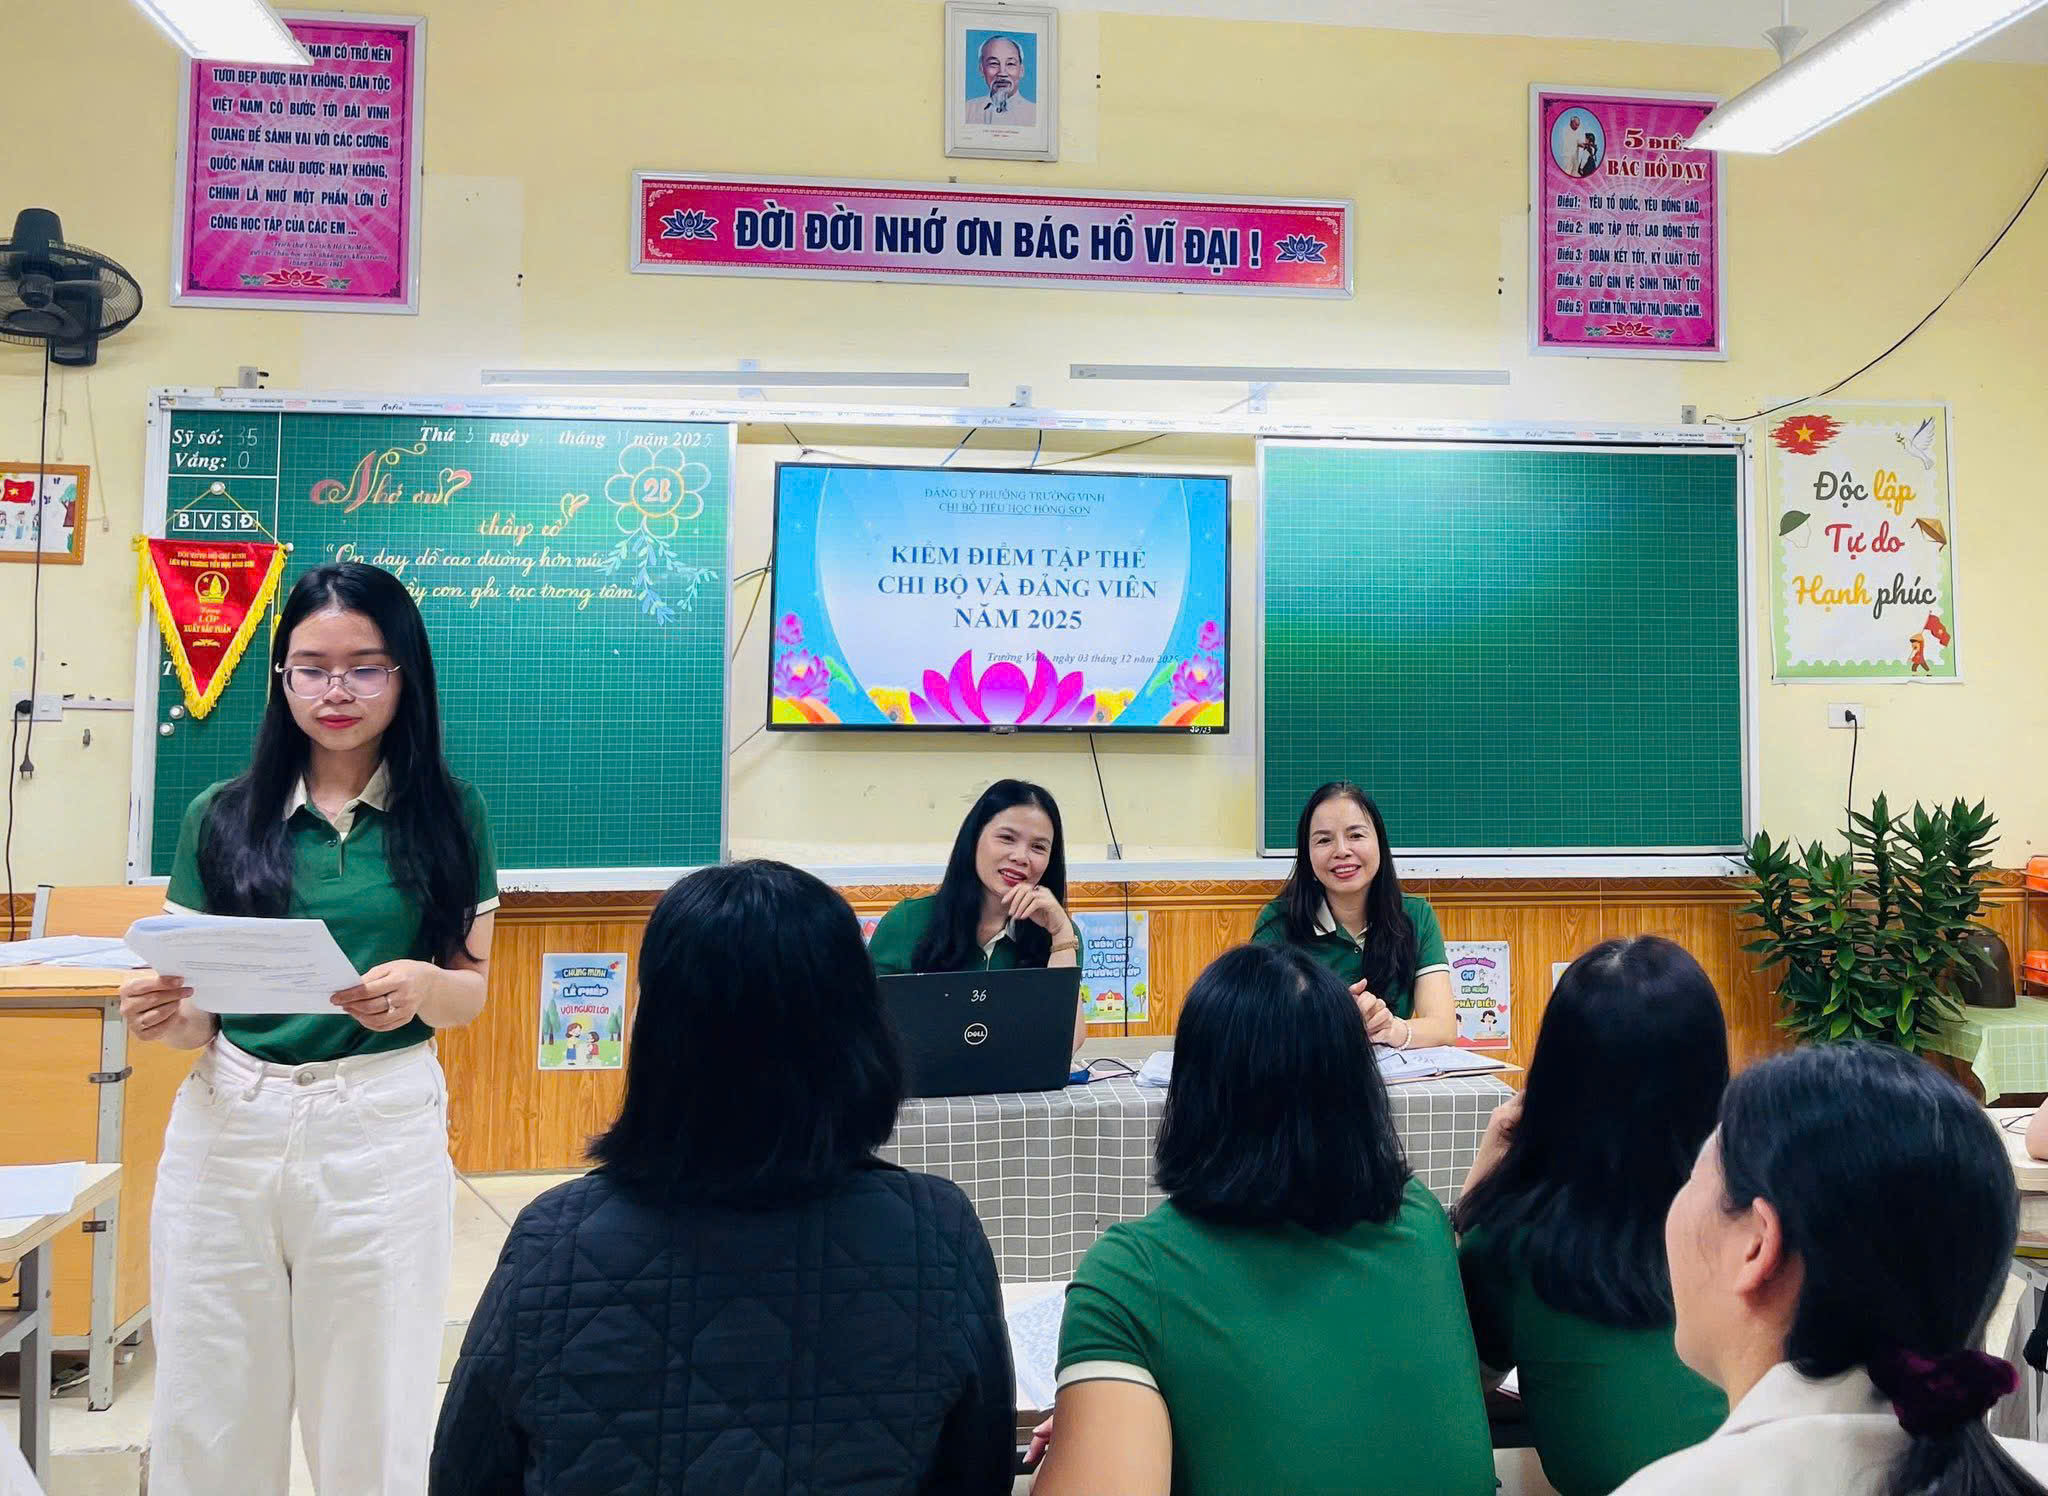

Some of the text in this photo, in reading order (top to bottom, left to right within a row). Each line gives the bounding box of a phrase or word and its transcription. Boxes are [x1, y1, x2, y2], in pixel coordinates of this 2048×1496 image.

[309, 42, 391, 61] NAM CÓ TRỞ NÊN
[213, 68, 235, 82] TƯƠI
[238, 70, 257, 86] ĐẸP
[260, 70, 286, 88] ĐƯỢC
[290, 73, 308, 86] HAY
[311, 72, 346, 89] KHÔNG,
[372, 75, 390, 92] TỘC
[212, 96, 233, 114] VIỆT
[240, 100, 263, 113] NAM
[270, 99, 283, 114] CÓ
[290, 100, 316, 116] BƯỚC
[344, 102, 360, 118] ĐÀI
[368, 106, 390, 119] VINH
[211, 127, 245, 142] QUANG
[264, 128, 292, 144] SÁNH
[295, 132, 311, 145] VAI
[314, 129, 330, 146] VỚI
[334, 131, 353, 147] CÁC
[356, 132, 389, 148] CƯỜNG
[1625, 130, 1644, 148] 5
[210, 153, 388, 179] QUỐC NĂM CHÂU ĐƯỢC HAY KHÔNG,
[1608, 154, 1705, 184] BÁC HỒ DẠY
[208, 184, 240, 200] CHÍNH
[246, 186, 259, 201] LÀ
[293, 188, 315, 206] MỘT
[354, 189, 374, 206] LỚN
[1589, 194, 1603, 210] YÊU
[1644, 196, 1658, 212] YÊU
[210, 214, 238, 230] CÔNG
[240, 218, 261, 233] HỌC
[264, 216, 282, 234] TẬP
[285, 214, 305, 232] CỦA
[308, 218, 328, 234] CÁC
[1589, 222, 1604, 238] HỌC
[1608, 220, 1622, 238] TẬP
[1645, 224, 1658, 237] LAO
[1686, 222, 1700, 238] TỐT
[735, 202, 794, 248] ĐỜI
[805, 204, 863, 251] ĐỜI
[875, 208, 947, 254] NHỚ
[956, 217, 1002, 257] ƠN
[1014, 215, 1080, 260] BÁC
[1091, 214, 1134, 262] HỒ
[1144, 220, 1177, 264] VĨ
[1184, 228, 1239, 274] ĐẠI
[1665, 250, 1684, 268] LUẬT
[1687, 249, 1700, 266] TỐT
[1625, 274, 1635, 292] VỆ
[1640, 276, 1658, 290] SINH
[1663, 276, 1682, 293] THẬT
[1686, 276, 1700, 291] TỐT
[172, 428, 194, 448] Sỹ
[198, 428, 224, 444] số:
[420, 427, 456, 442] Thứ
[489, 429, 529, 447] ngày
[560, 430, 606, 448] tháng
[633, 432, 668, 446] năm
[175, 450, 227, 472] Vắng:
[1078, 493, 1104, 502] VINH
[1814, 469, 1916, 516] Độc lập
[938, 502, 958, 512] CHI
[1824, 520, 1906, 560] Tự do
[442, 556, 471, 566] cao
[539, 546, 572, 568] hơn
[892, 540, 1146, 572] KIỂM ĐIỂM TẬP THỂ
[432, 576, 595, 610] con ghi tạc trong
[878, 572, 1159, 600] CHI BỘ VÀ ĐẢNG VIÊN
[1792, 572, 1937, 620] Hạnh phúc
[952, 602, 1082, 630] NĂM 2025
[987, 652, 1022, 664] Trường
[1052, 652, 1076, 664] ngày
[1078, 654, 1088, 663] 03
[1090, 653, 1118, 665] tháng
[1120, 654, 1132, 664] 12
[1134, 654, 1155, 664] năm
[970, 989, 987, 1002] 36
[966, 1030, 985, 1038] DELL
